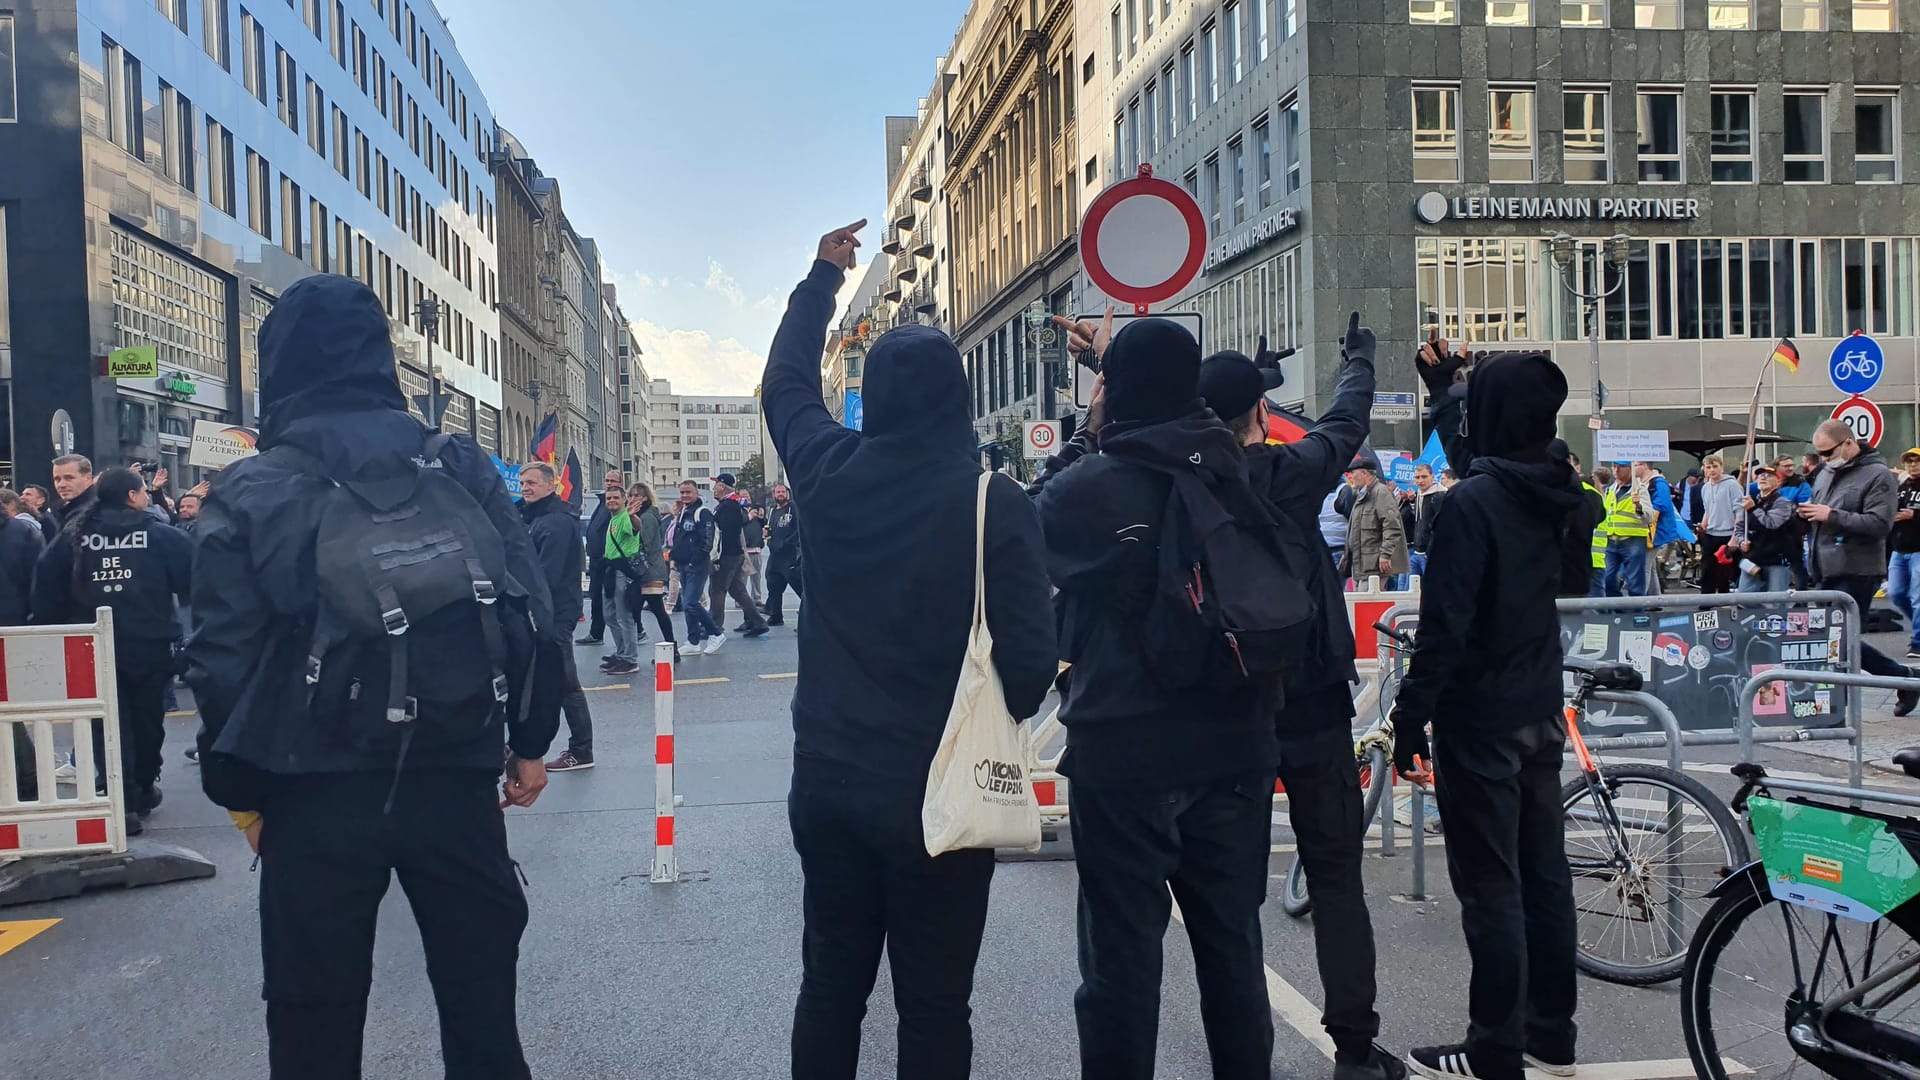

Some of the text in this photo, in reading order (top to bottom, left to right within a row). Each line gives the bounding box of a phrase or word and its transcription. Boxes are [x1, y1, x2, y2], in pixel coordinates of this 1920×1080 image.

[1452, 196, 1701, 219] LEINEMANN PARTNER
[1205, 207, 1296, 269] LEINEMANN PARTNER
[1035, 430, 1050, 442] 30
[209, 446, 245, 456] ZUERST!
[1033, 449, 1053, 457] ZONE
[1394, 470, 1416, 480] ZUER
[81, 531, 148, 551] POLIZEI
[102, 556, 121, 568] BE
[92, 568, 132, 581] 12120
[1781, 644, 1827, 661] MLM
[989, 778, 1023, 795] LEIPZIG
